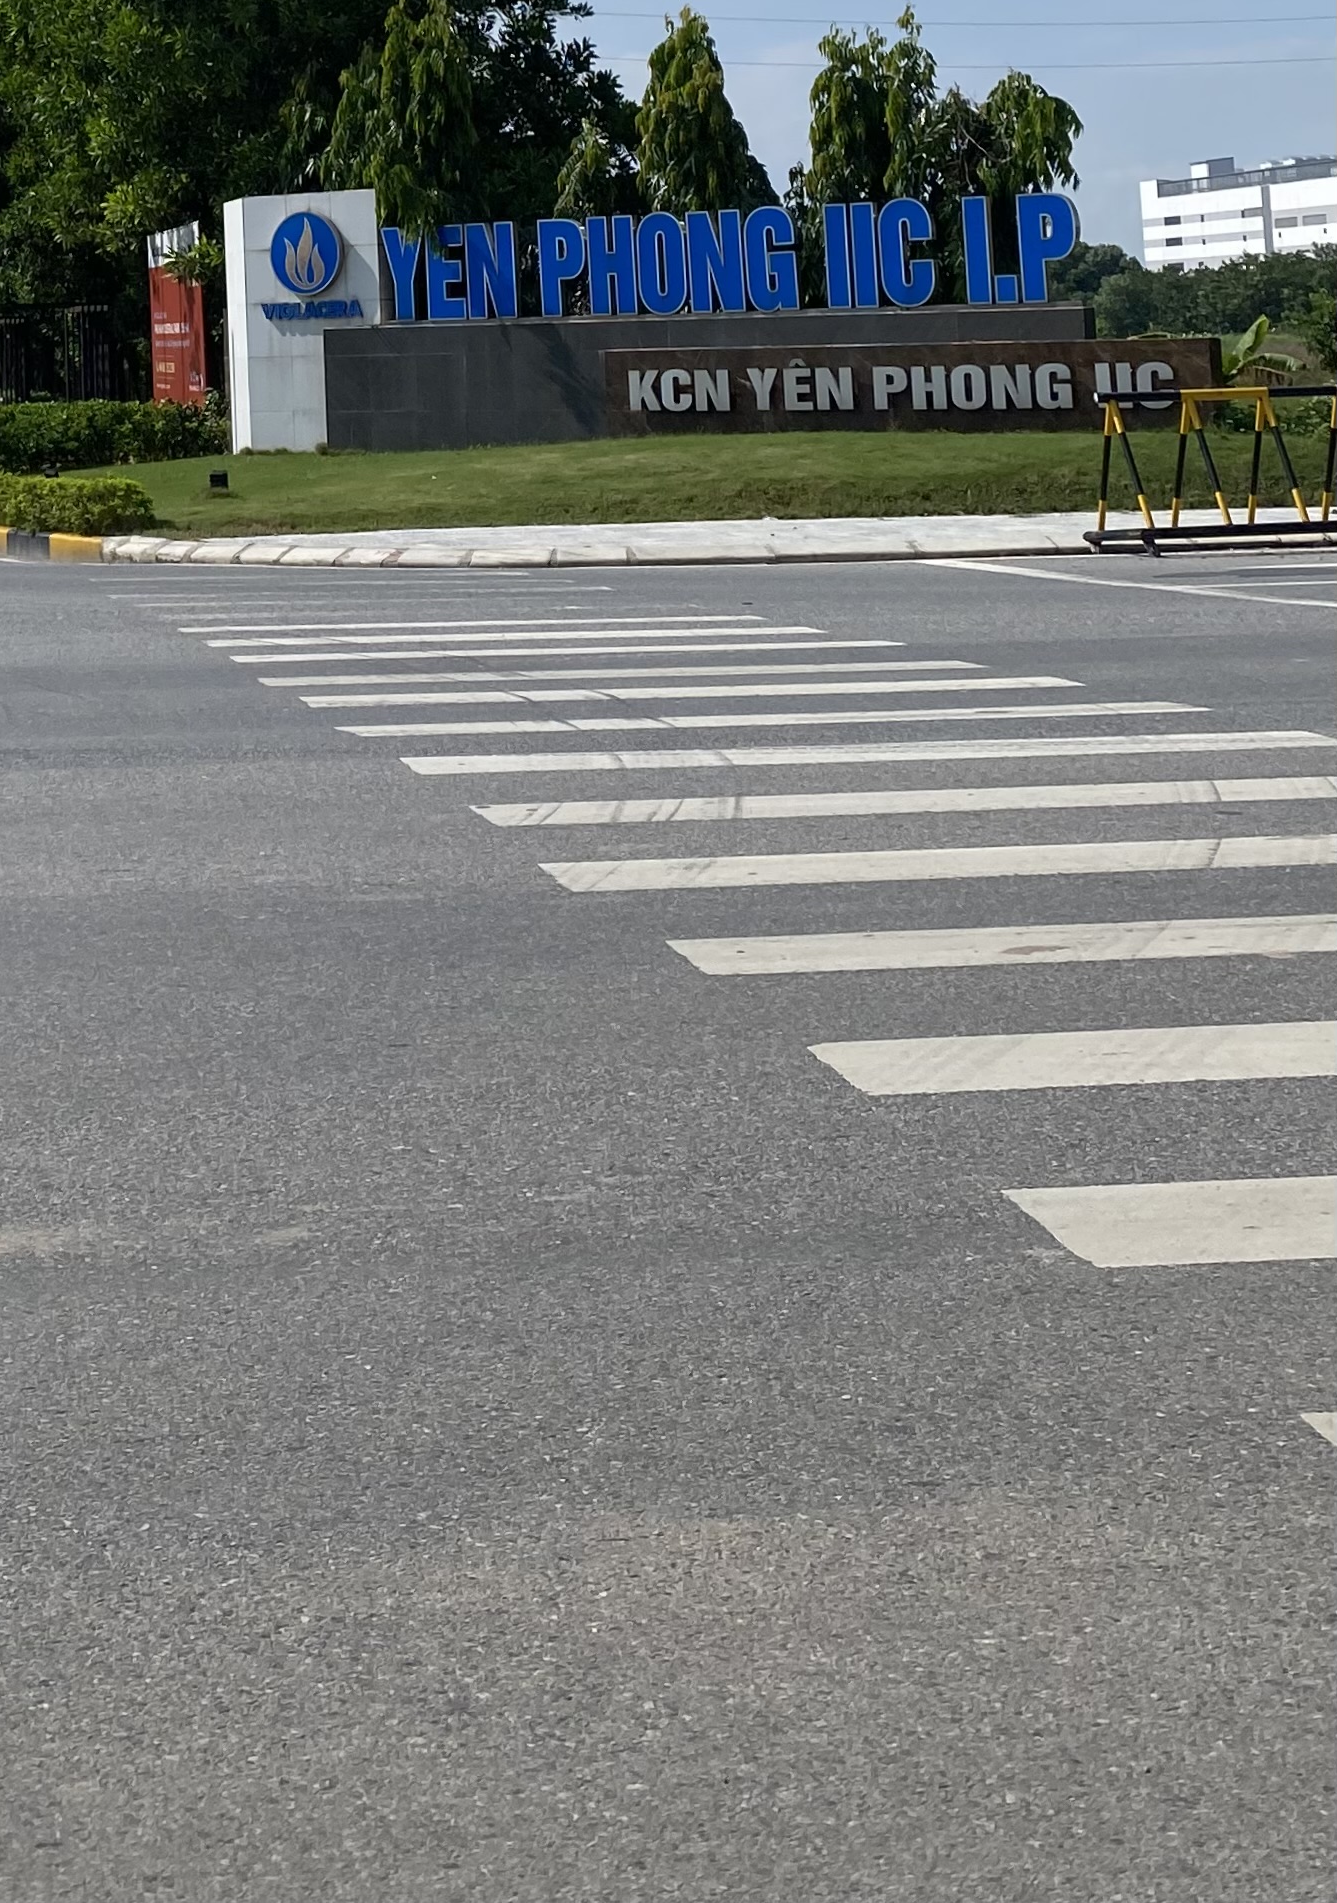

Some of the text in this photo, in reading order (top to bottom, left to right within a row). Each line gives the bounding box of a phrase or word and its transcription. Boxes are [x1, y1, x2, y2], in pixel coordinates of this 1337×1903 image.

[380, 193, 1078, 321] YEN PHONG IIC I.P
[261, 299, 364, 321] VIGLACERA
[628, 358, 1175, 412] KCN YÊN PHONG IIC
